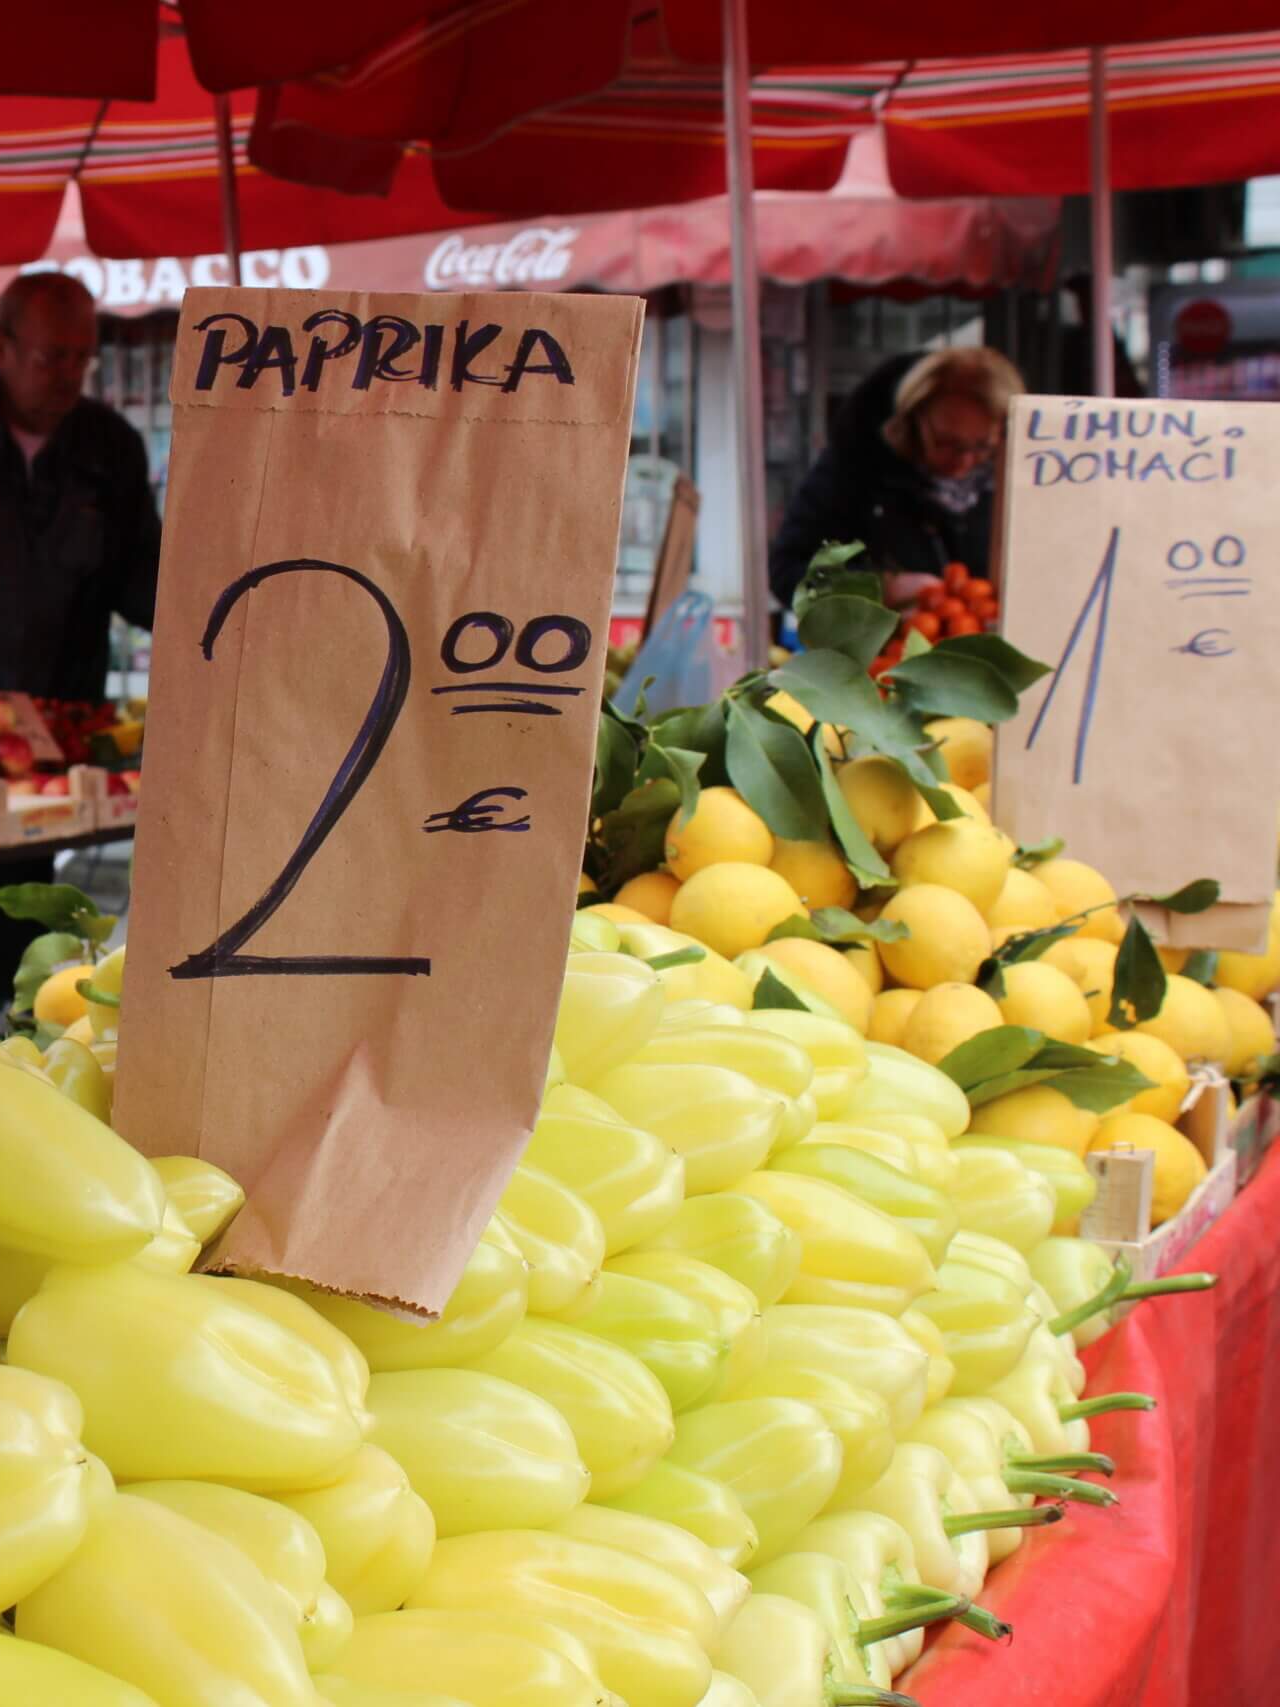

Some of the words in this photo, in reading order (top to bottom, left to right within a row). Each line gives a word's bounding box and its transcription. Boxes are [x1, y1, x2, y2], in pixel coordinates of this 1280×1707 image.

[193, 309, 576, 397] PAPRIKA
[440, 611, 592, 674] 00
[1025, 526, 1119, 785] 1
[168, 558, 432, 979] 2
[421, 787, 531, 834] €
